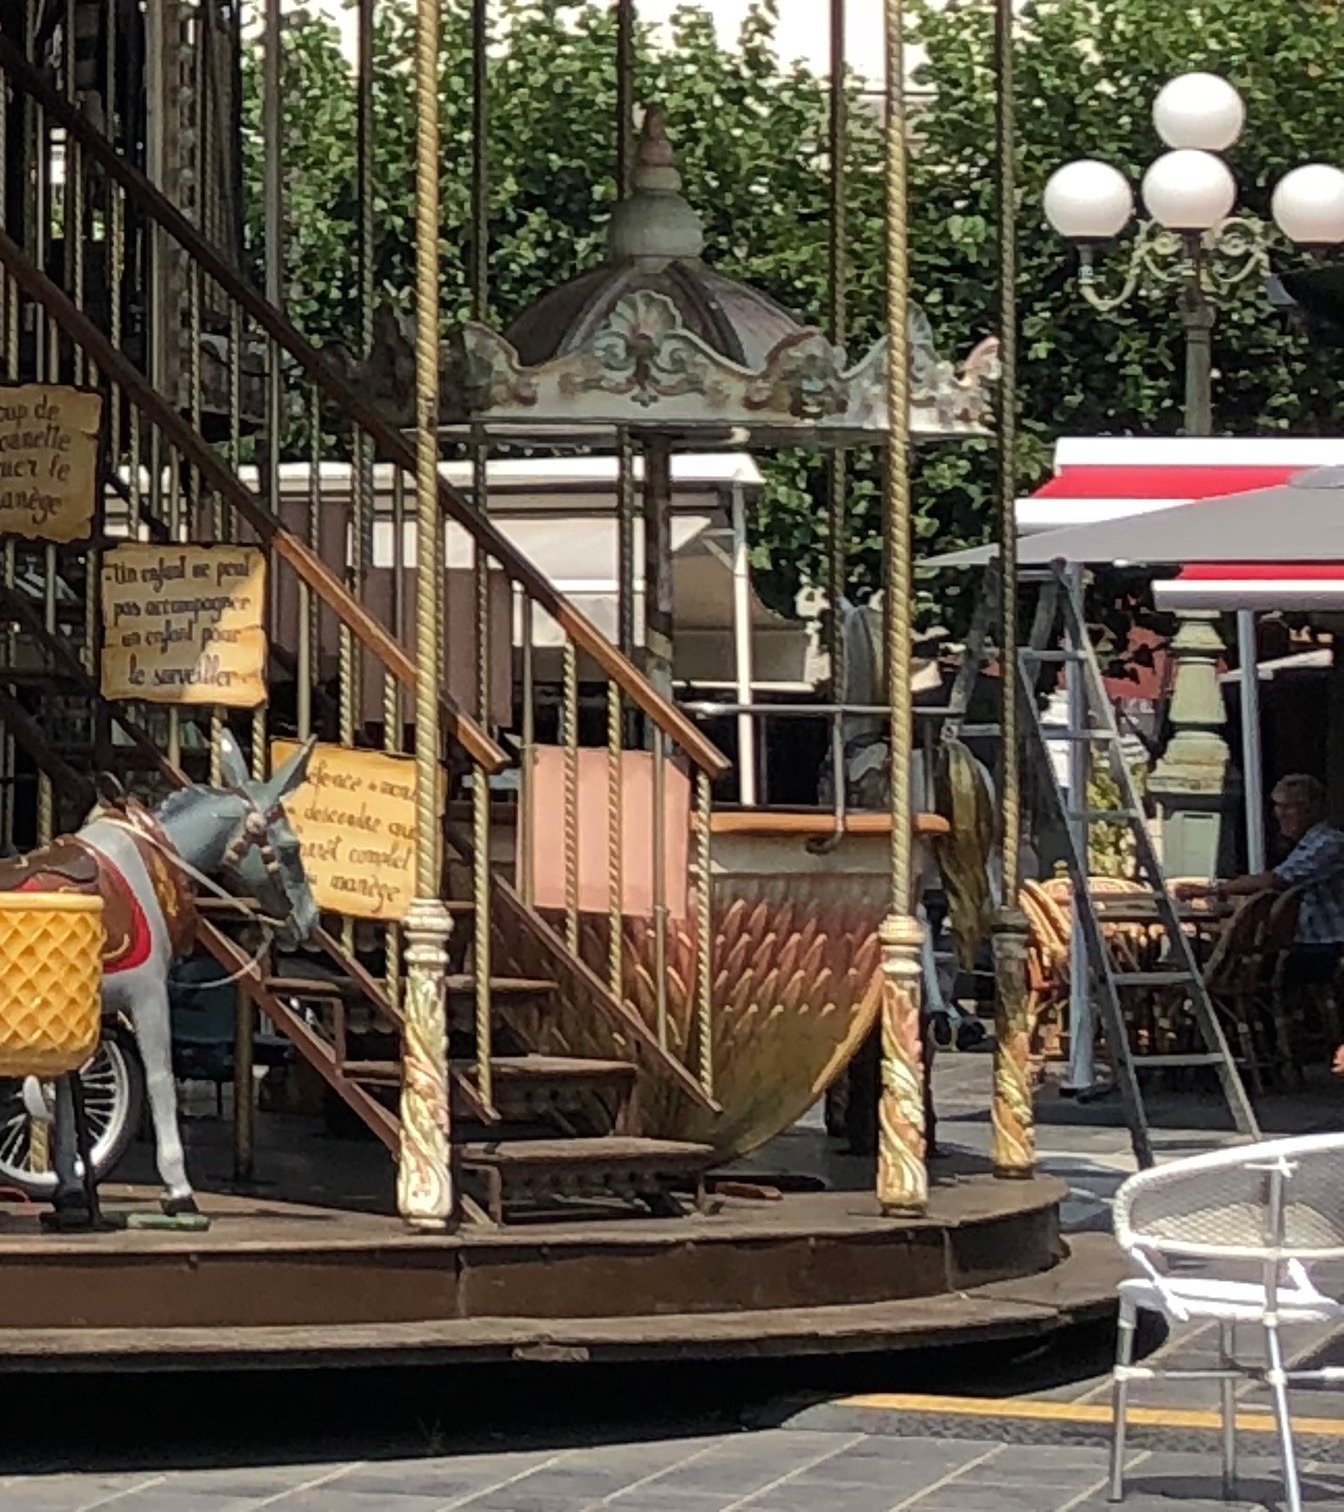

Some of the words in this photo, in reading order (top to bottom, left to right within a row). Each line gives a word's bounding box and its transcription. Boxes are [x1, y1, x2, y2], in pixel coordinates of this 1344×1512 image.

[34, 393, 61, 420] de
[49, 453, 72, 481] le
[113, 600, 142, 628] pas
